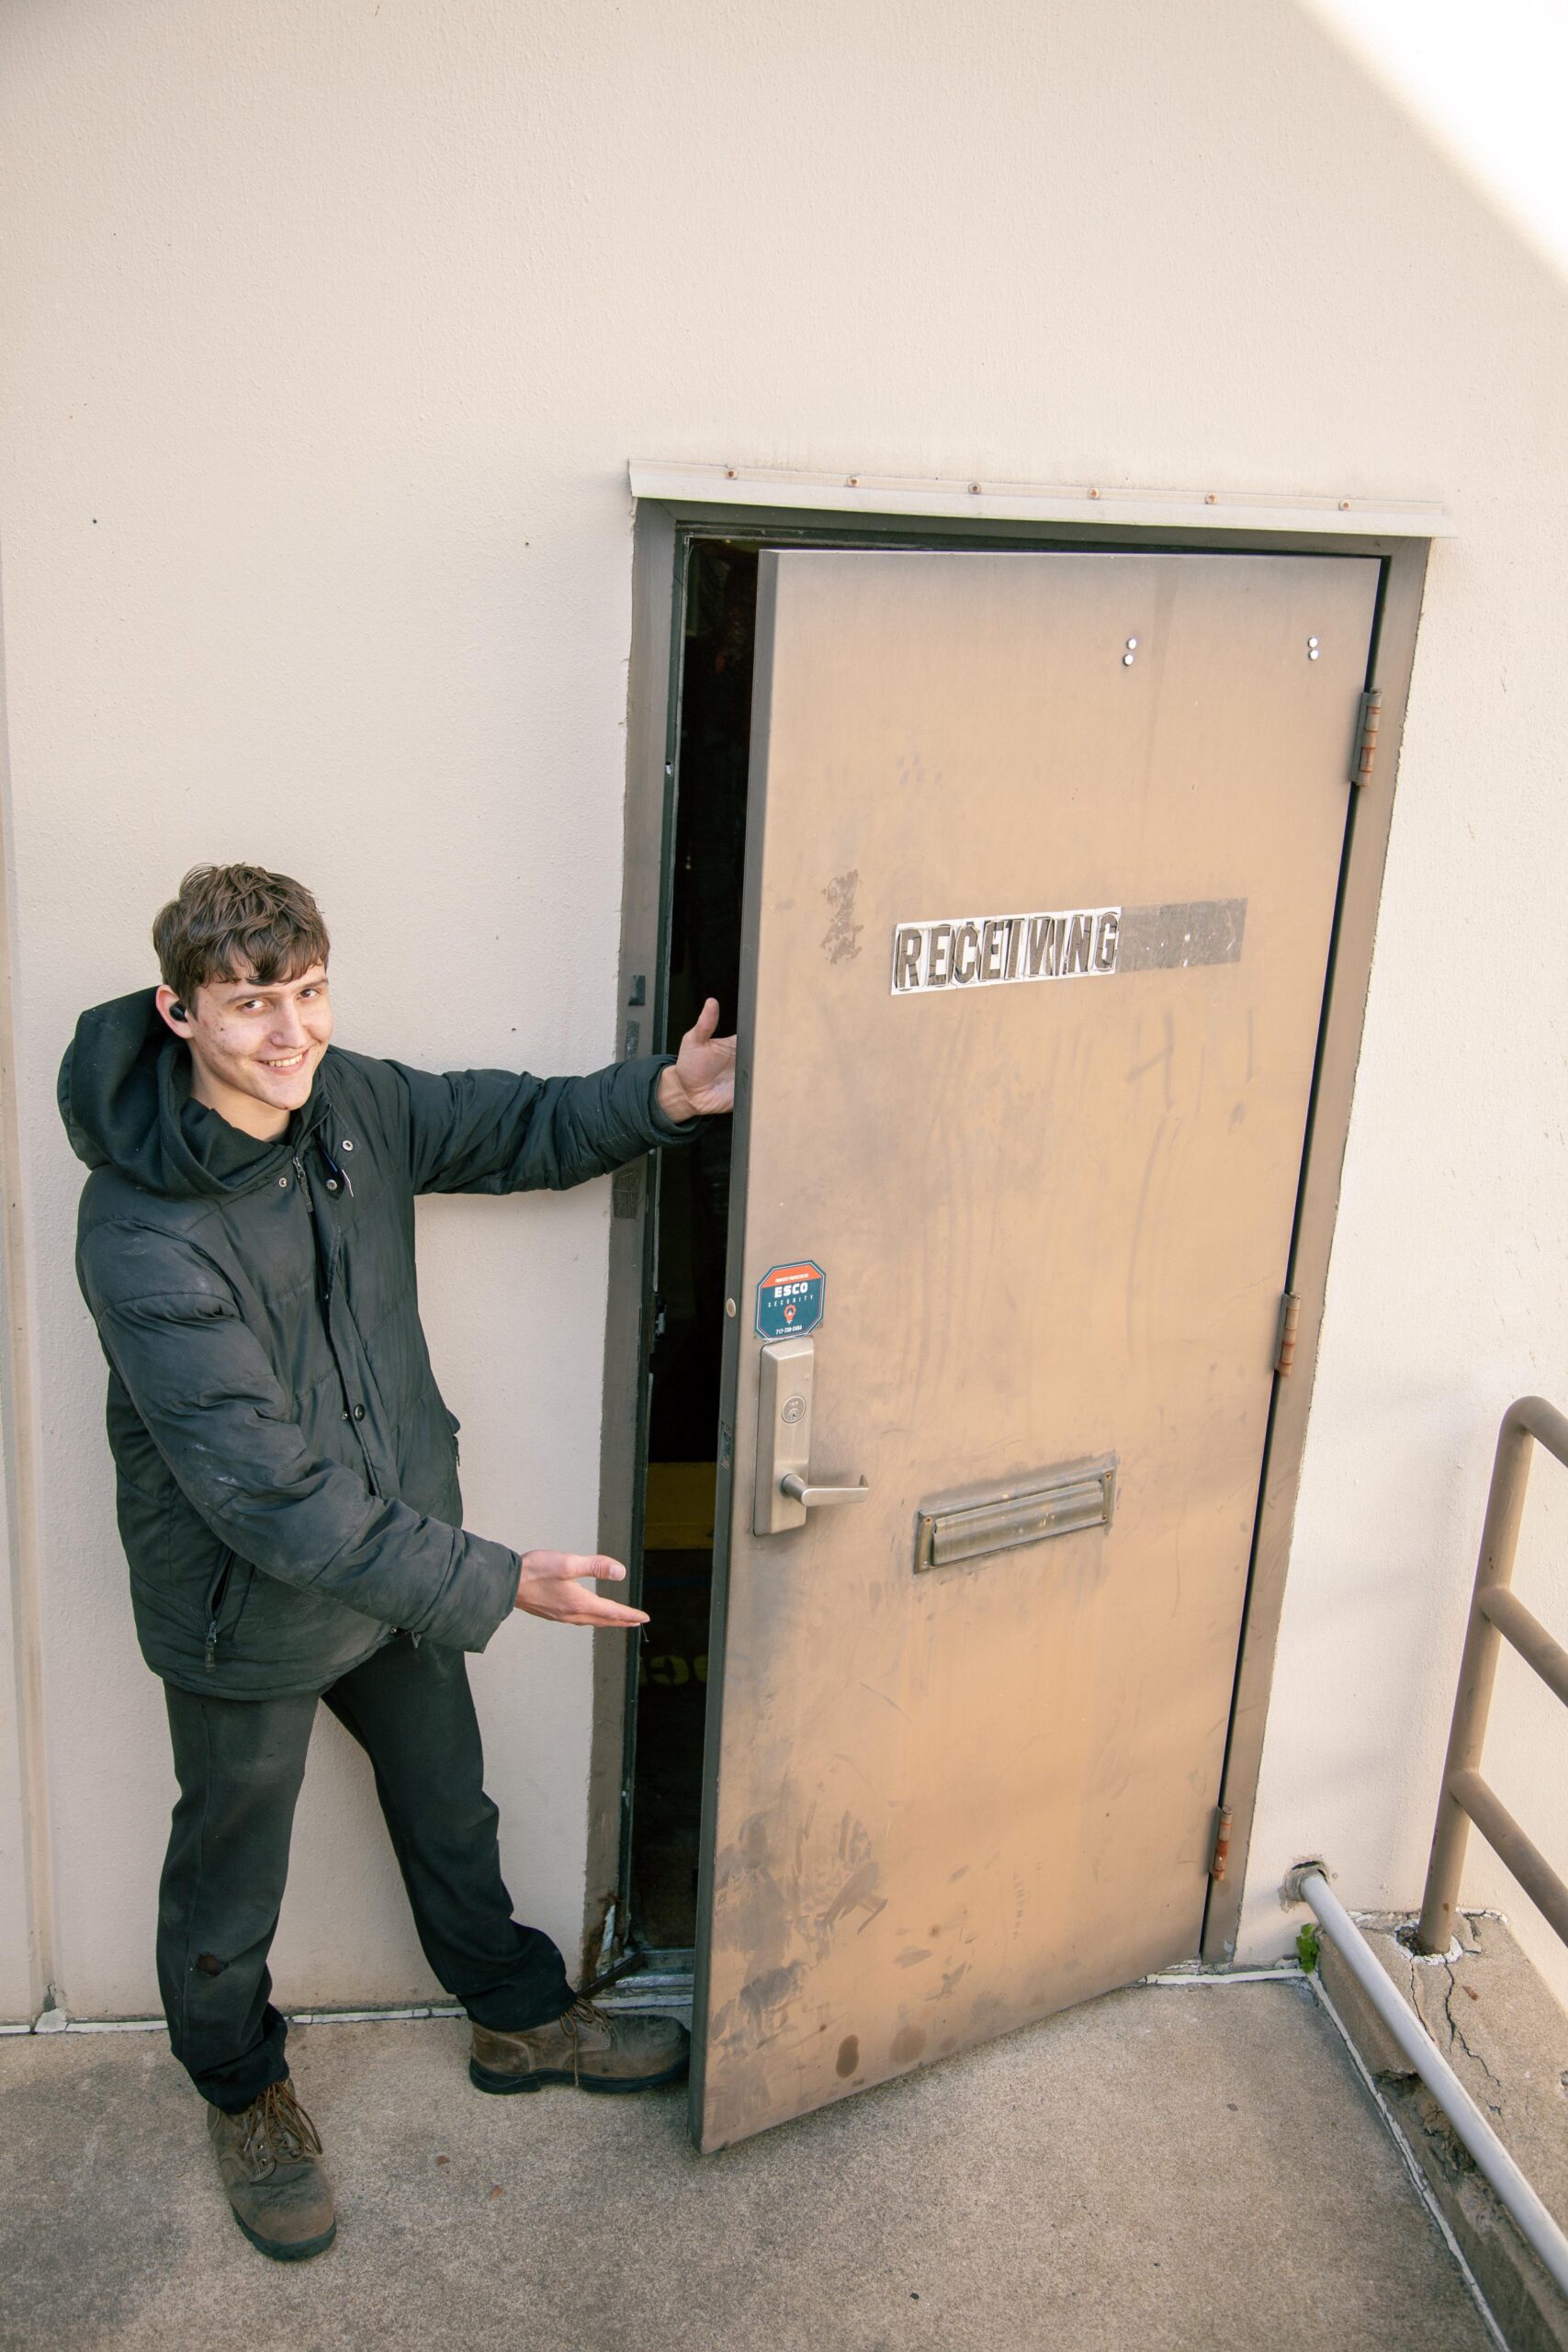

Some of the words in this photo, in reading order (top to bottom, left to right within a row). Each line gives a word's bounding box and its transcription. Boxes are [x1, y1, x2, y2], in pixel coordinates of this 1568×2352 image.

[895, 910, 1121, 992] RECEIVING
[773, 1282, 808, 1298] ESCO
[767, 1295, 813, 1308] SECURITY
